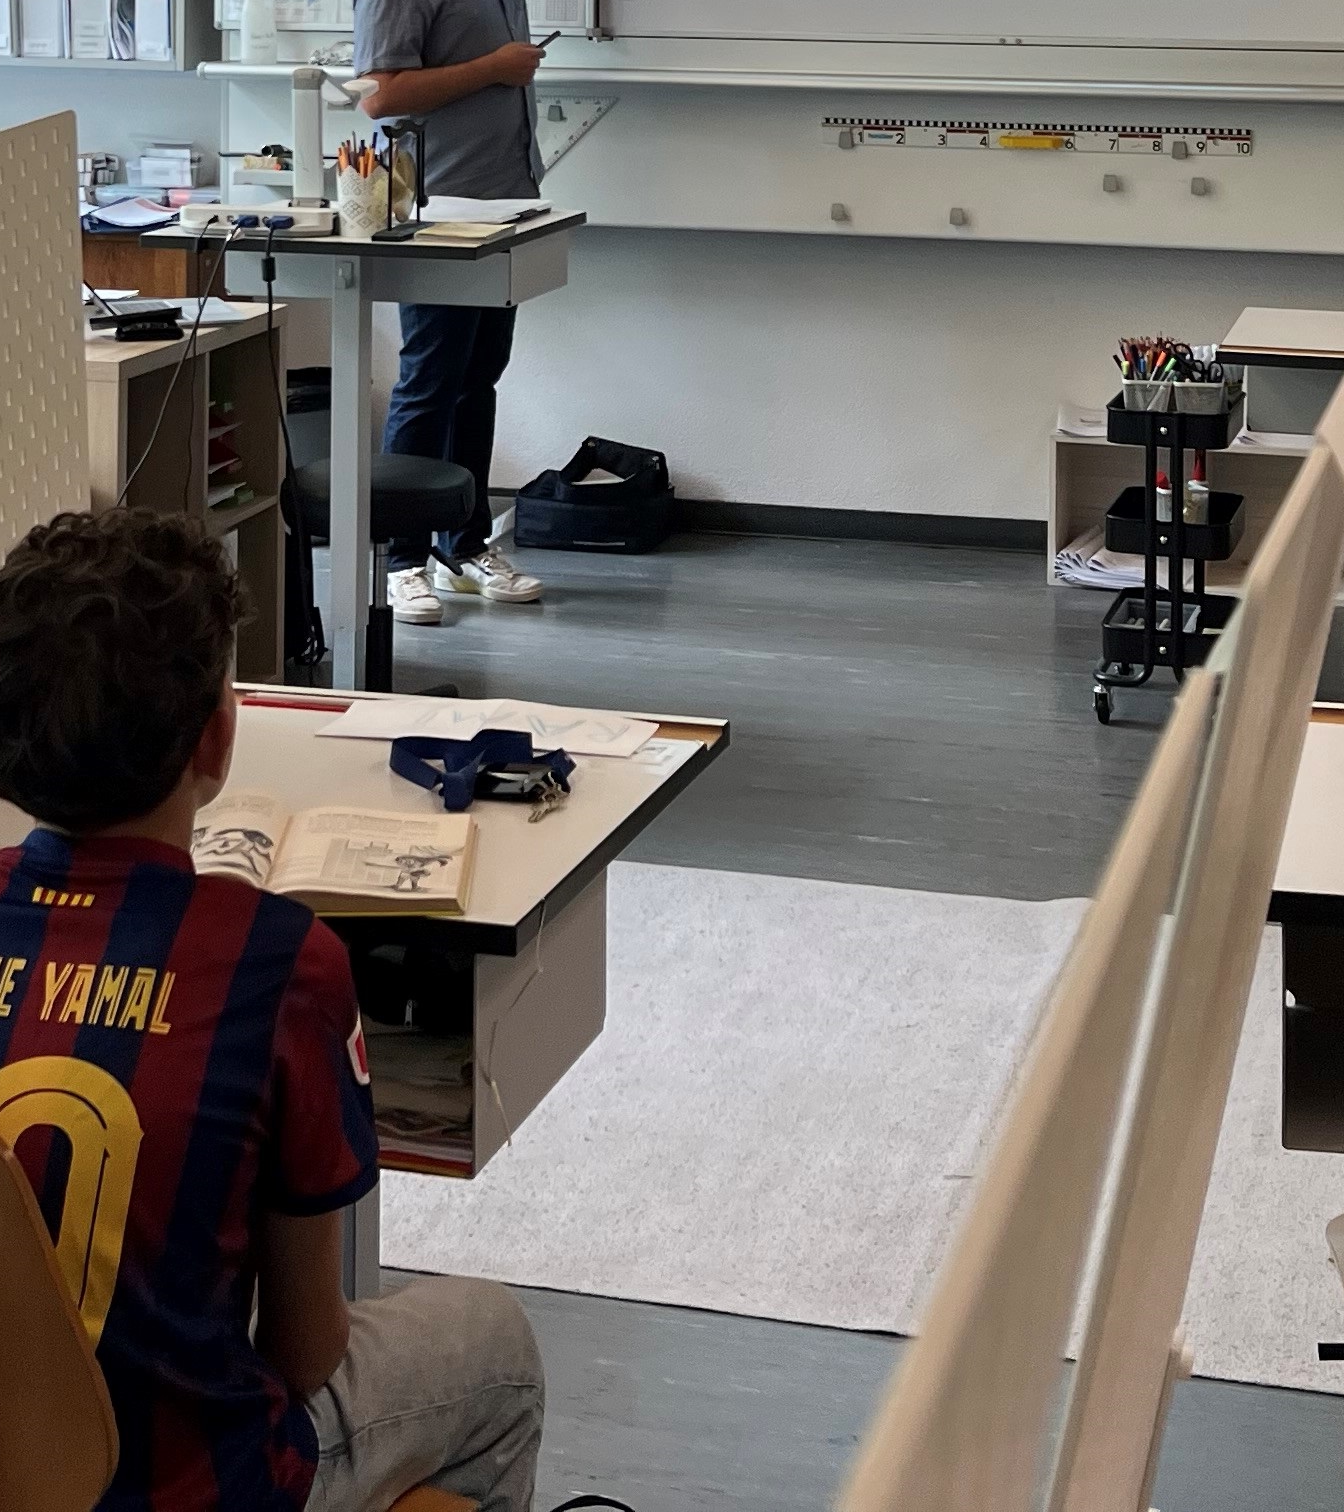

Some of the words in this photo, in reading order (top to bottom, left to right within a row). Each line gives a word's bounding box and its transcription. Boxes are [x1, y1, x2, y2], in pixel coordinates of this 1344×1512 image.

[857, 131, 863, 143] 1
[895, 133, 904, 145] 2
[937, 134, 946, 146] 3
[979, 135, 988, 147] 4
[1065, 138, 1074, 150] 6
[1109, 139, 1117, 151] 7
[1152, 140, 1161, 152] 8
[1197, 141, 1205, 153] 9
[1236, 142, 1250, 155] 10
[40, 961, 178, 1036] YAMAL
